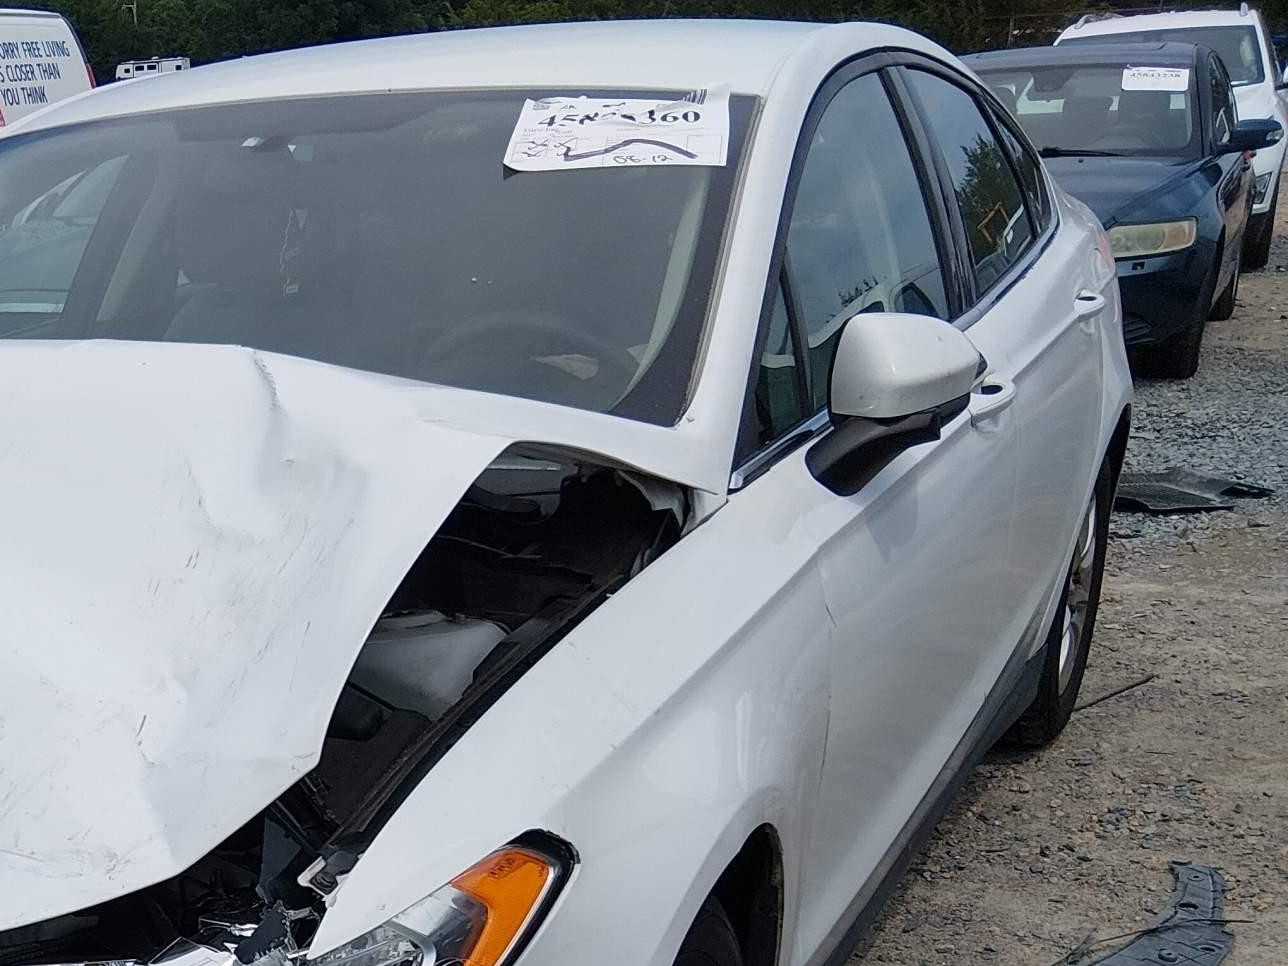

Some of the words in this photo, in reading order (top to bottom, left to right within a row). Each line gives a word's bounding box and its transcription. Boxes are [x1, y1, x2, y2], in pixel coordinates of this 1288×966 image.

[21, 41, 43, 59] FREE
[41, 40, 70, 58] LIVING
[5, 63, 37, 83] CLOSER
[36, 62, 61, 81] THAN
[0, 87, 20, 107] YOU
[20, 86, 49, 105] THINK
